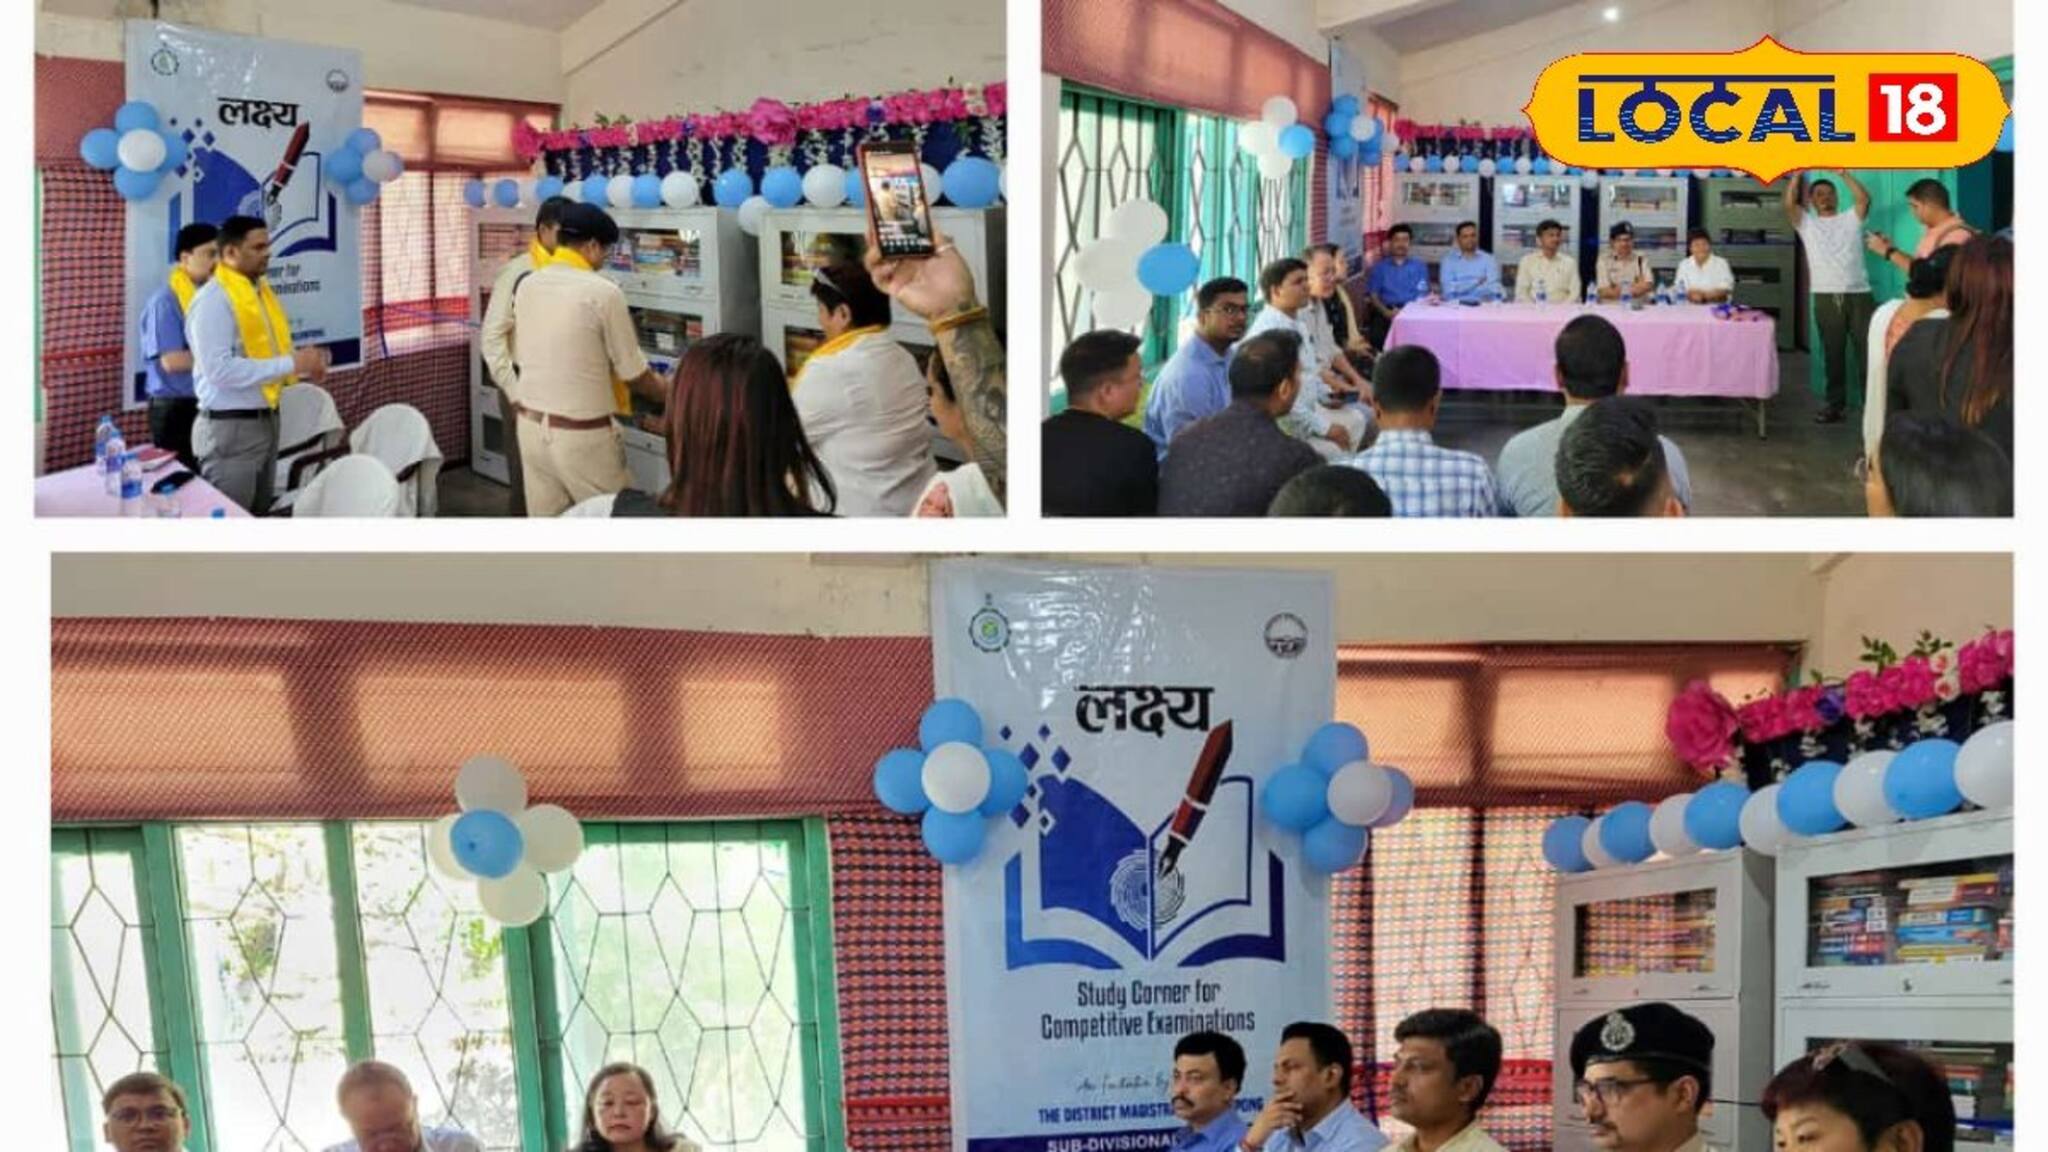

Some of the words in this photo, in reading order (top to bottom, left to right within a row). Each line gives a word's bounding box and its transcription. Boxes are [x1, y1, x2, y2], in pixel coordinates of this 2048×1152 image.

[217, 96, 301, 129] लक्ष्य
[1075, 685, 1215, 738] लक्ष्य
[1077, 980, 1127, 1010] Study
[1131, 979, 1191, 1006] Corner
[1195, 978, 1221, 1003] for
[1041, 1011, 1143, 1042] Competitive
[1147, 1007, 1256, 1036] Examinations
[1038, 1107, 1060, 1124] THE
[1063, 1105, 1116, 1122] DISTRICT
